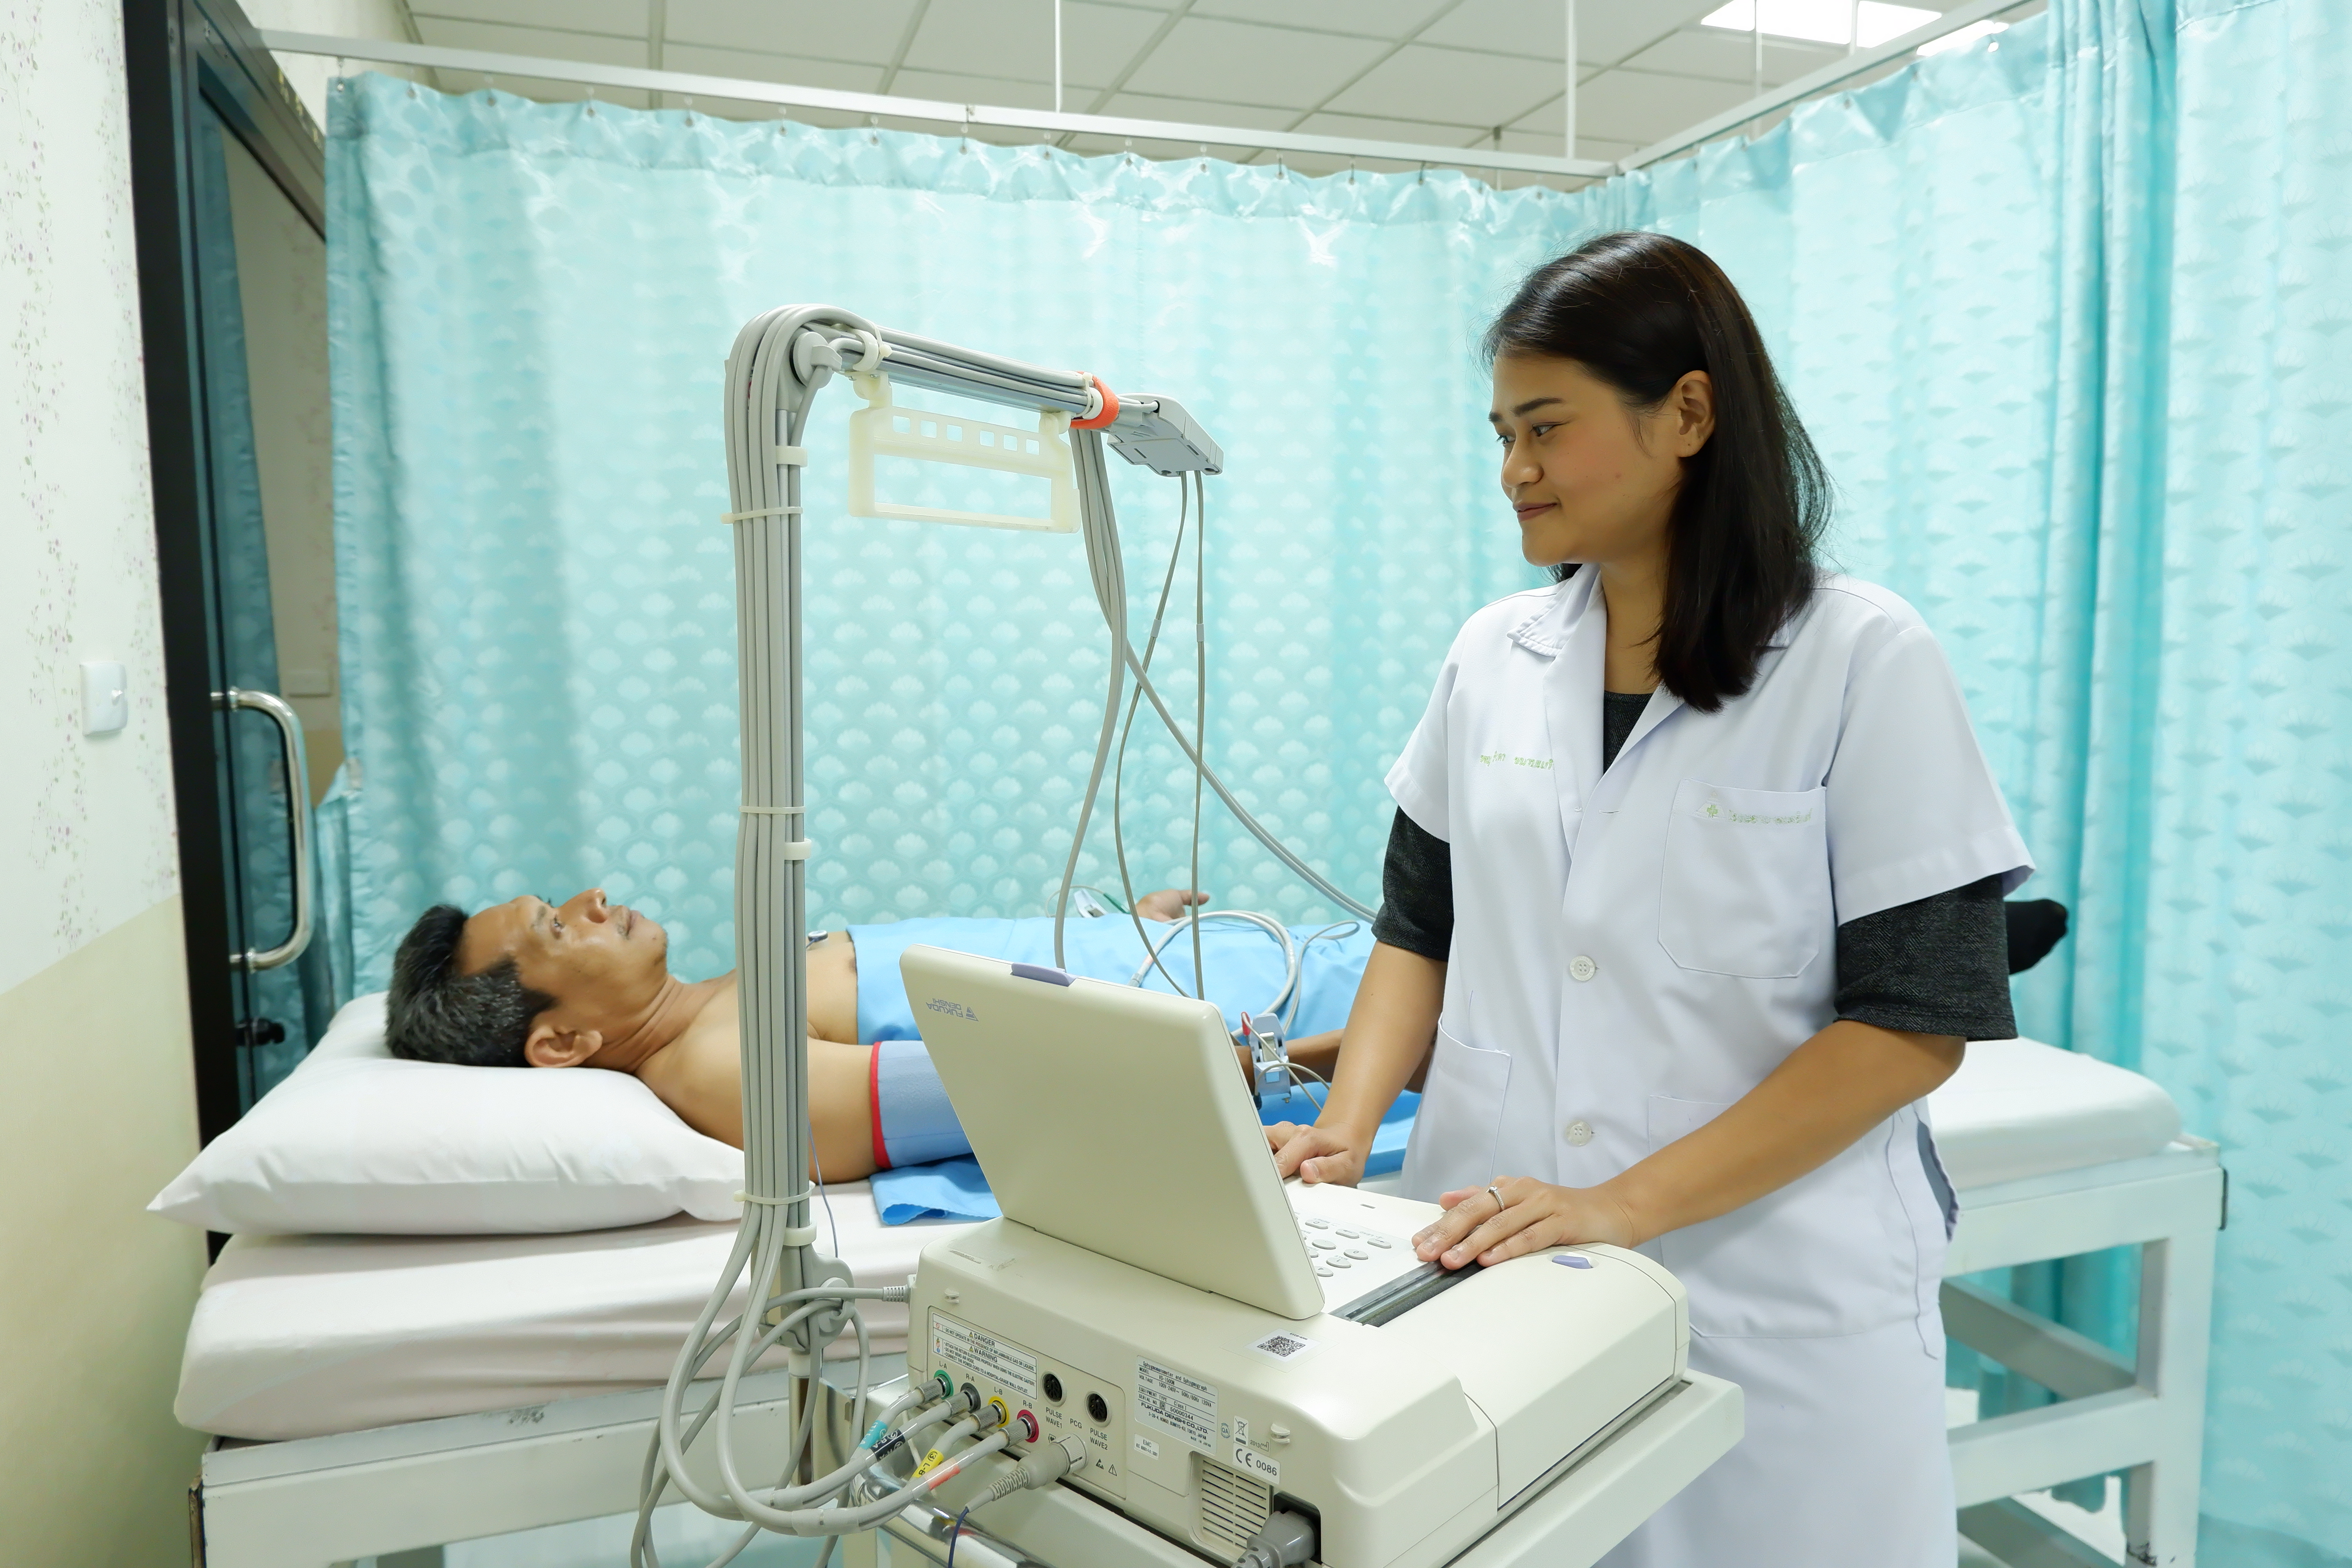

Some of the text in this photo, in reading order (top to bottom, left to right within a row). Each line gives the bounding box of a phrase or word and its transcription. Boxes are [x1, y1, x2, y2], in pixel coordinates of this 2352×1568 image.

[926, 1002, 964, 1018] FUKUDA
[932, 998, 961, 1010] DENSHI
[955, 1332, 966, 1341] OPERATE
[976, 1341, 989, 1351] PRESENCE
[993, 1350, 1012, 1361] INFLAMMABLE
[974, 1333, 995, 1347] DANGER
[946, 1352, 957, 1361] CONNECT
[974, 1347, 997, 1363] WARNING
[968, 1352, 981, 1362] ELECTRODE
[981, 1358, 993, 1367] PROPERLY
[1012, 1373, 1023, 1381] ELECTRIC
[966, 1373, 975, 1382] R-A
[1143, 1361, 1173, 1377] Sphygmomanometer
[1183, 1377, 1207, 1391] Sphygmograph
[1159, 1374, 1174, 1385] VS-1500N
[994, 1386, 1002, 1395] L-B
[1139, 1374, 1153, 1384] VOLTAGE
[1181, 1391, 1199, 1403] 50Hz/60Hz
[1202, 1399, 1211, 1408] 120VA
[1139, 1387, 1157, 1397] EQUIPMENT
[1023, 1399, 1032, 1409] R-B
[1139, 1394, 1151, 1402] SERIAL
[1171, 1407, 1193, 1420] 50000344
[1046, 1407, 1062, 1420] PULSE
[1142, 1402, 1163, 1415] FUKUDA
[1165, 1412, 1185, 1424] DENSHI
[1045, 1416, 1062, 1428] WAVE1
[1070, 1418, 1082, 1429] PCG
[1091, 1428, 1107, 1441] PULSE
[1090, 1436, 1107, 1450] WAVE2
[1250, 1439, 1260, 1448] 2013
[1236, 1448, 1277, 1476] CE 0086
[918, 1463, 930, 1475] L-B
